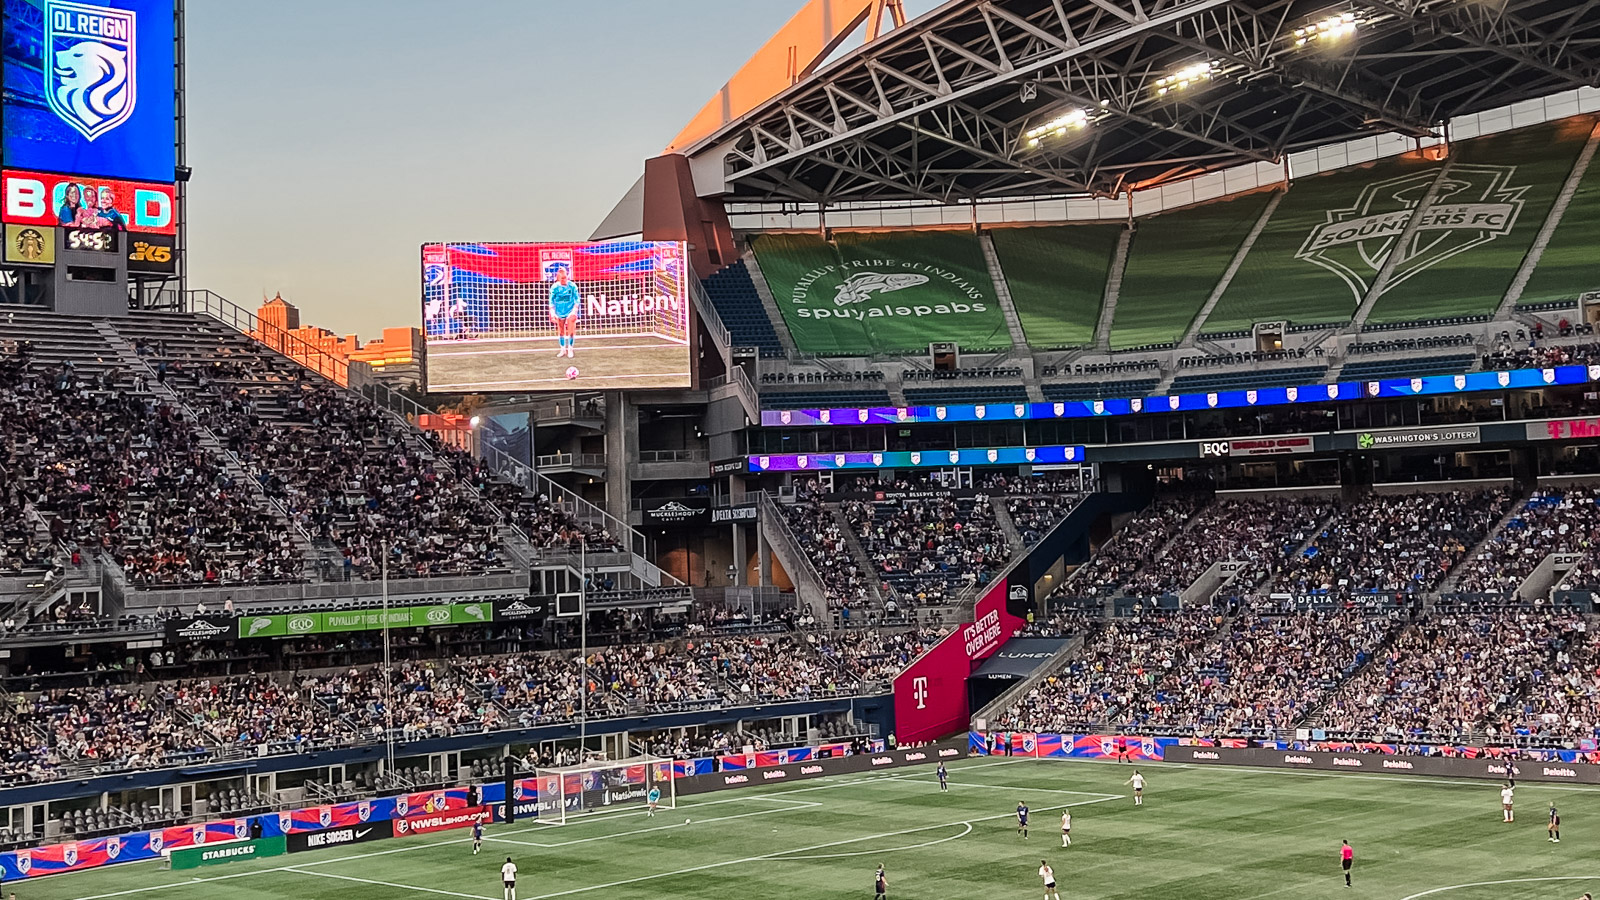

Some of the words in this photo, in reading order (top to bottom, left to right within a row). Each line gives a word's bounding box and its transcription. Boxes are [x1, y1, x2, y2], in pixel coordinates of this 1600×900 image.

[54, 10, 76, 32] OL
[77, 13, 127, 40] REIGN
[1366, 207, 1469, 225] SEATLE
[1471, 213, 1505, 226] FC
[793, 265, 835, 304] PUYALLUP
[839, 259, 896, 273] TRIBE
[923, 265, 983, 300] INDIANS
[1375, 433, 1438, 444] WASHINGTON'S
[1441, 431, 1477, 440] LOTTERY
[1203, 442, 1229, 456] EQC
[329, 615, 360, 627] PUYALLUP
[963, 624, 976, 642] IT'S
[975, 609, 999, 634] BETTER
[179, 629, 221, 637] MUCKLESHOOT
[966, 634, 985, 656] OVER
[983, 621, 1001, 644] HERE
[519, 801, 551, 814] NWSL
[307, 832, 326, 847] NIKE
[326, 829, 353, 844] SOCCER
[202, 845, 255, 861] STARBUCKS
